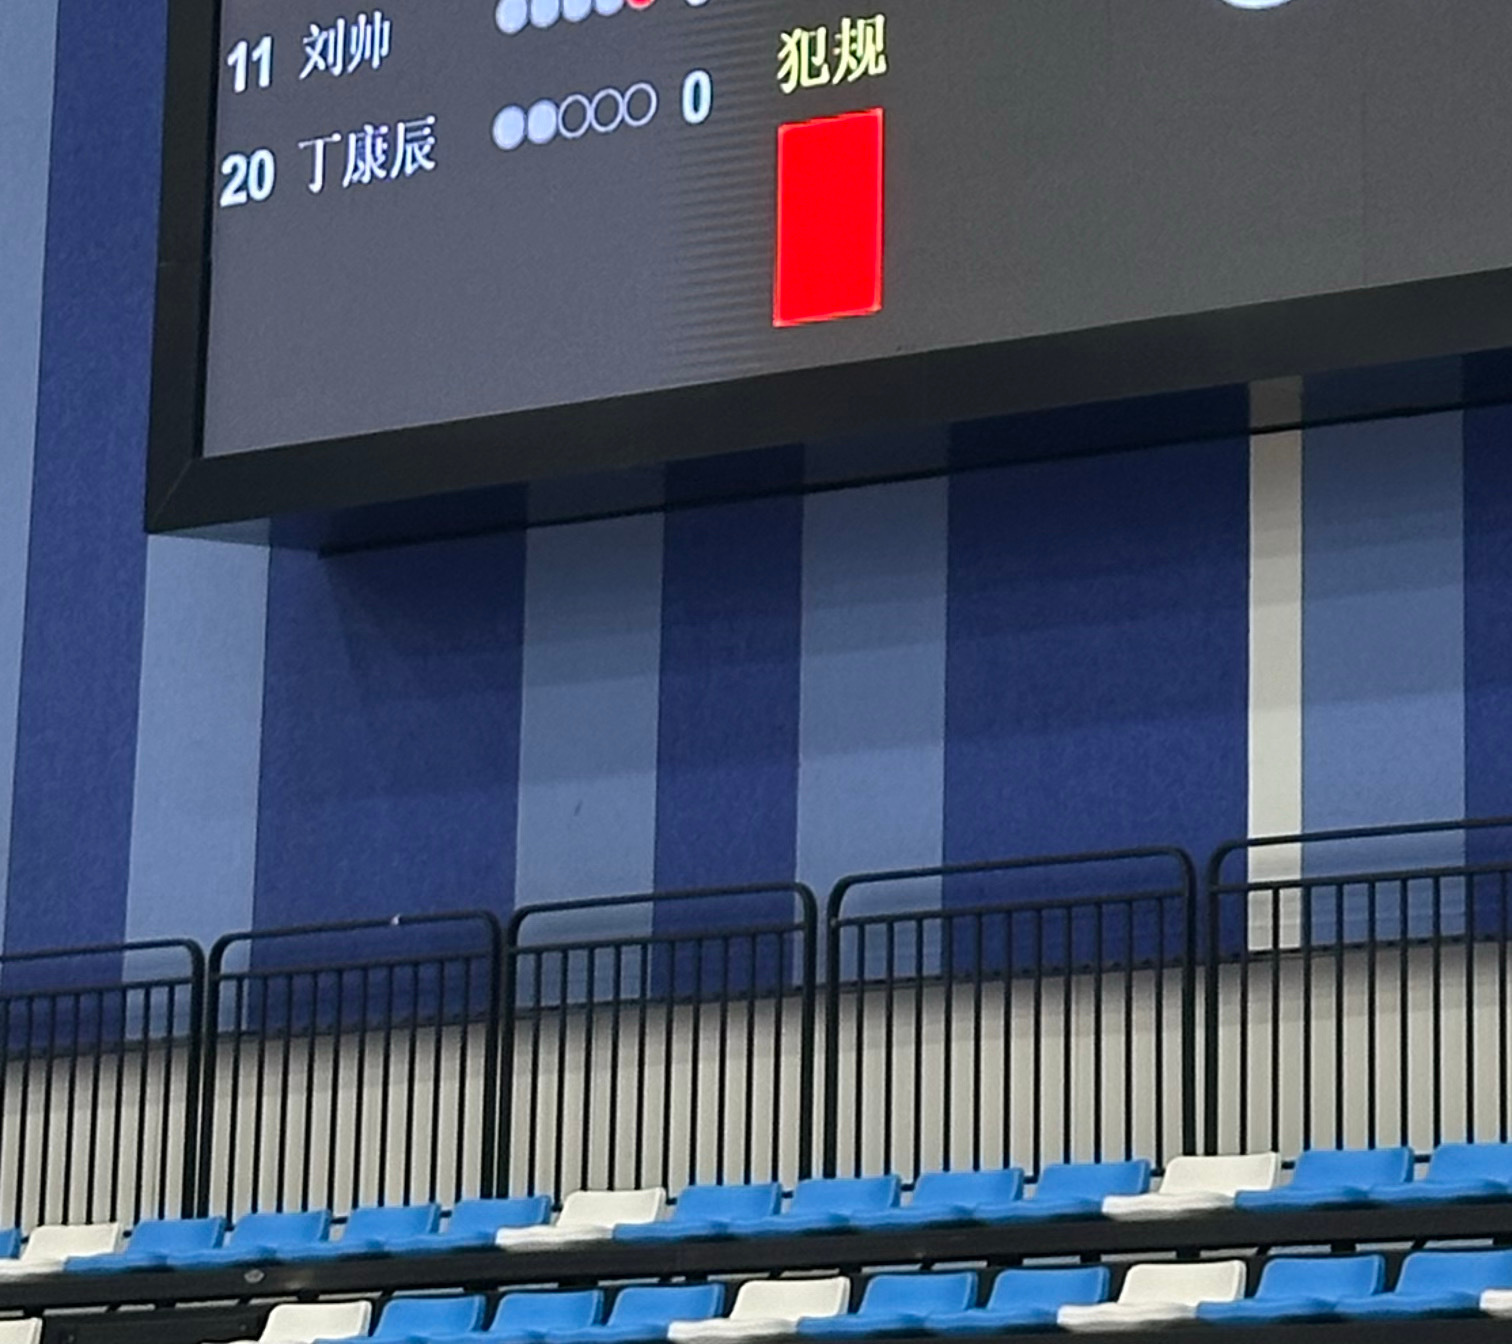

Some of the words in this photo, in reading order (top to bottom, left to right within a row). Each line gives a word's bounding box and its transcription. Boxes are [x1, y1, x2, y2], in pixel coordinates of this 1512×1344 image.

[227, 36, 272, 93] 11
[299, 10, 391, 80] 刘帅
[776, 14, 887, 94] 犯规
[219, 149, 275, 207] 20
[298, 115, 436, 193] 丁康辰
[682, 70, 711, 124] 0
